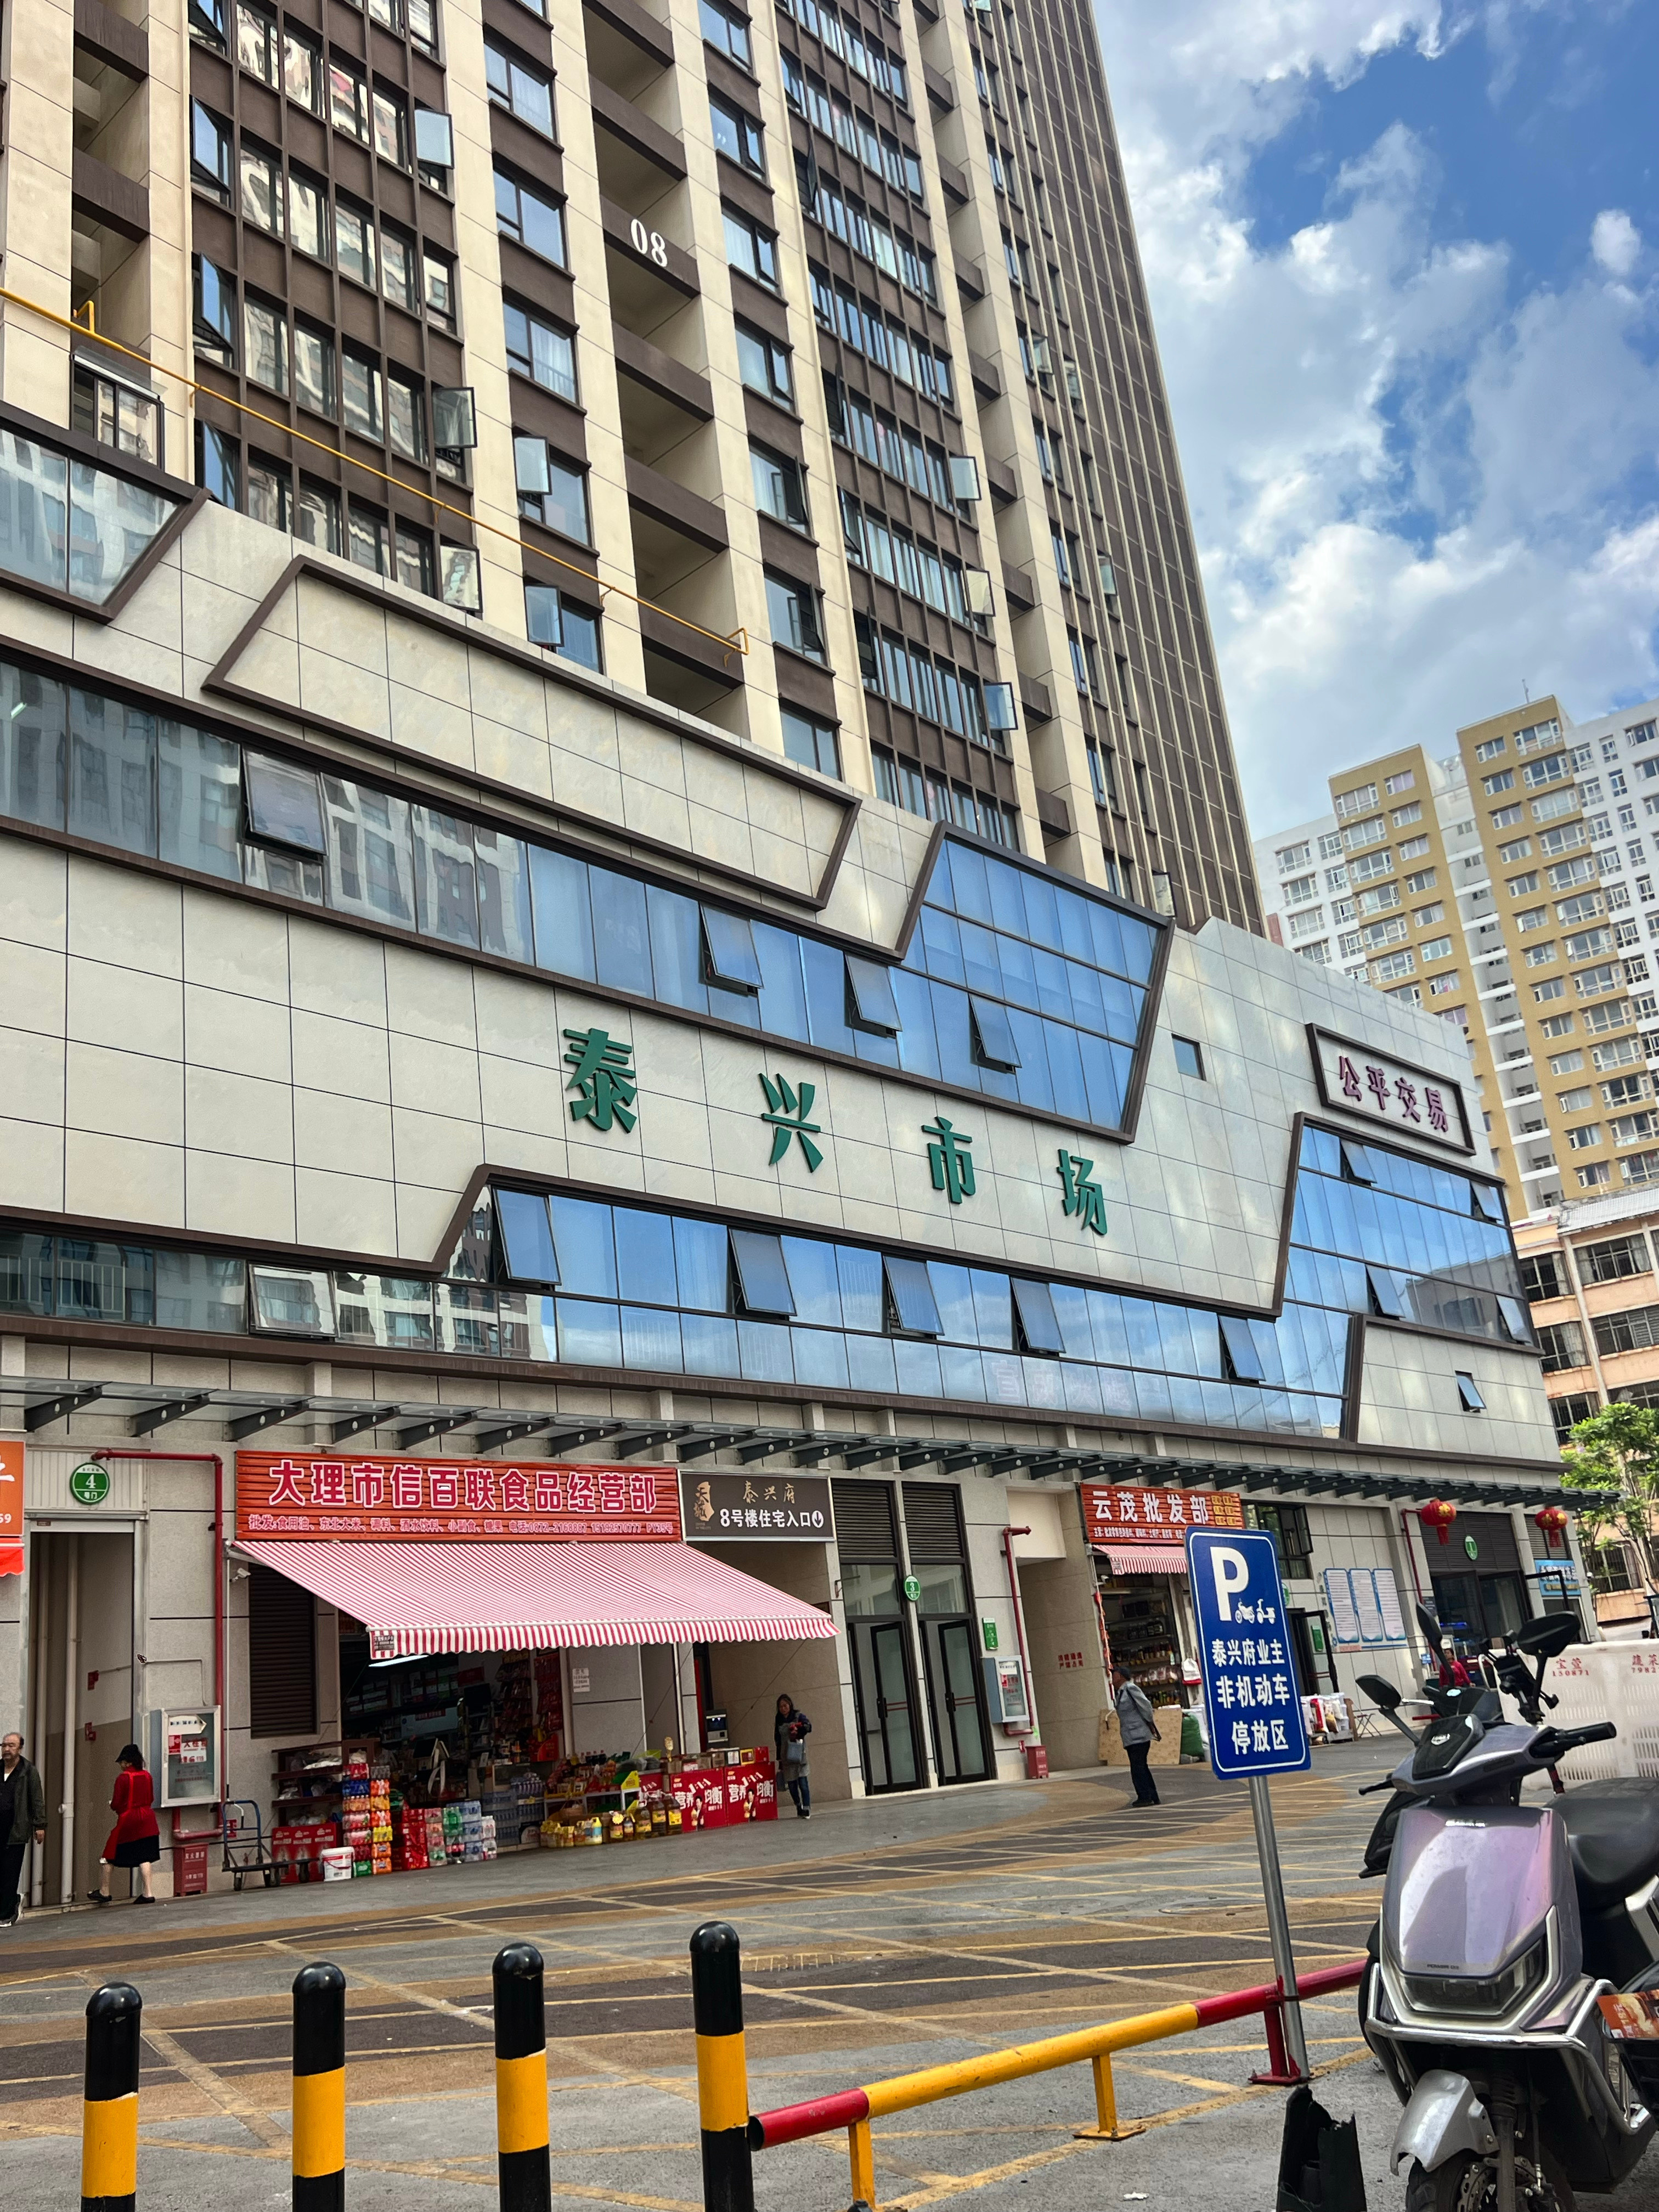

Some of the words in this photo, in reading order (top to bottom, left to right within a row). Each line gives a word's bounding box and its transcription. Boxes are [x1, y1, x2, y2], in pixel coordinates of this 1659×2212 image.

[631, 219, 668, 267] 08
[1339, 1056, 1449, 1132] 公平交易
[562, 1027, 1108, 1235] 泰兴市场
[86, 1474, 97, 1488] 4
[268, 1459, 657, 1514] 大理市信百联食品经营部
[742, 1480, 795, 1504] 泰兴府
[720, 1508, 811, 1528] 8号楼住宅入口
[1092, 1491, 1209, 1525] 云茂批发部
[910, 1582, 915, 1591] 3
[1210, 1546, 1249, 1622] P
[1211, 1638, 1285, 1667] 泰兴府业主
[1216, 1673, 1290, 1709] 非机动车
[1232, 1719, 1289, 1755] 停放区
